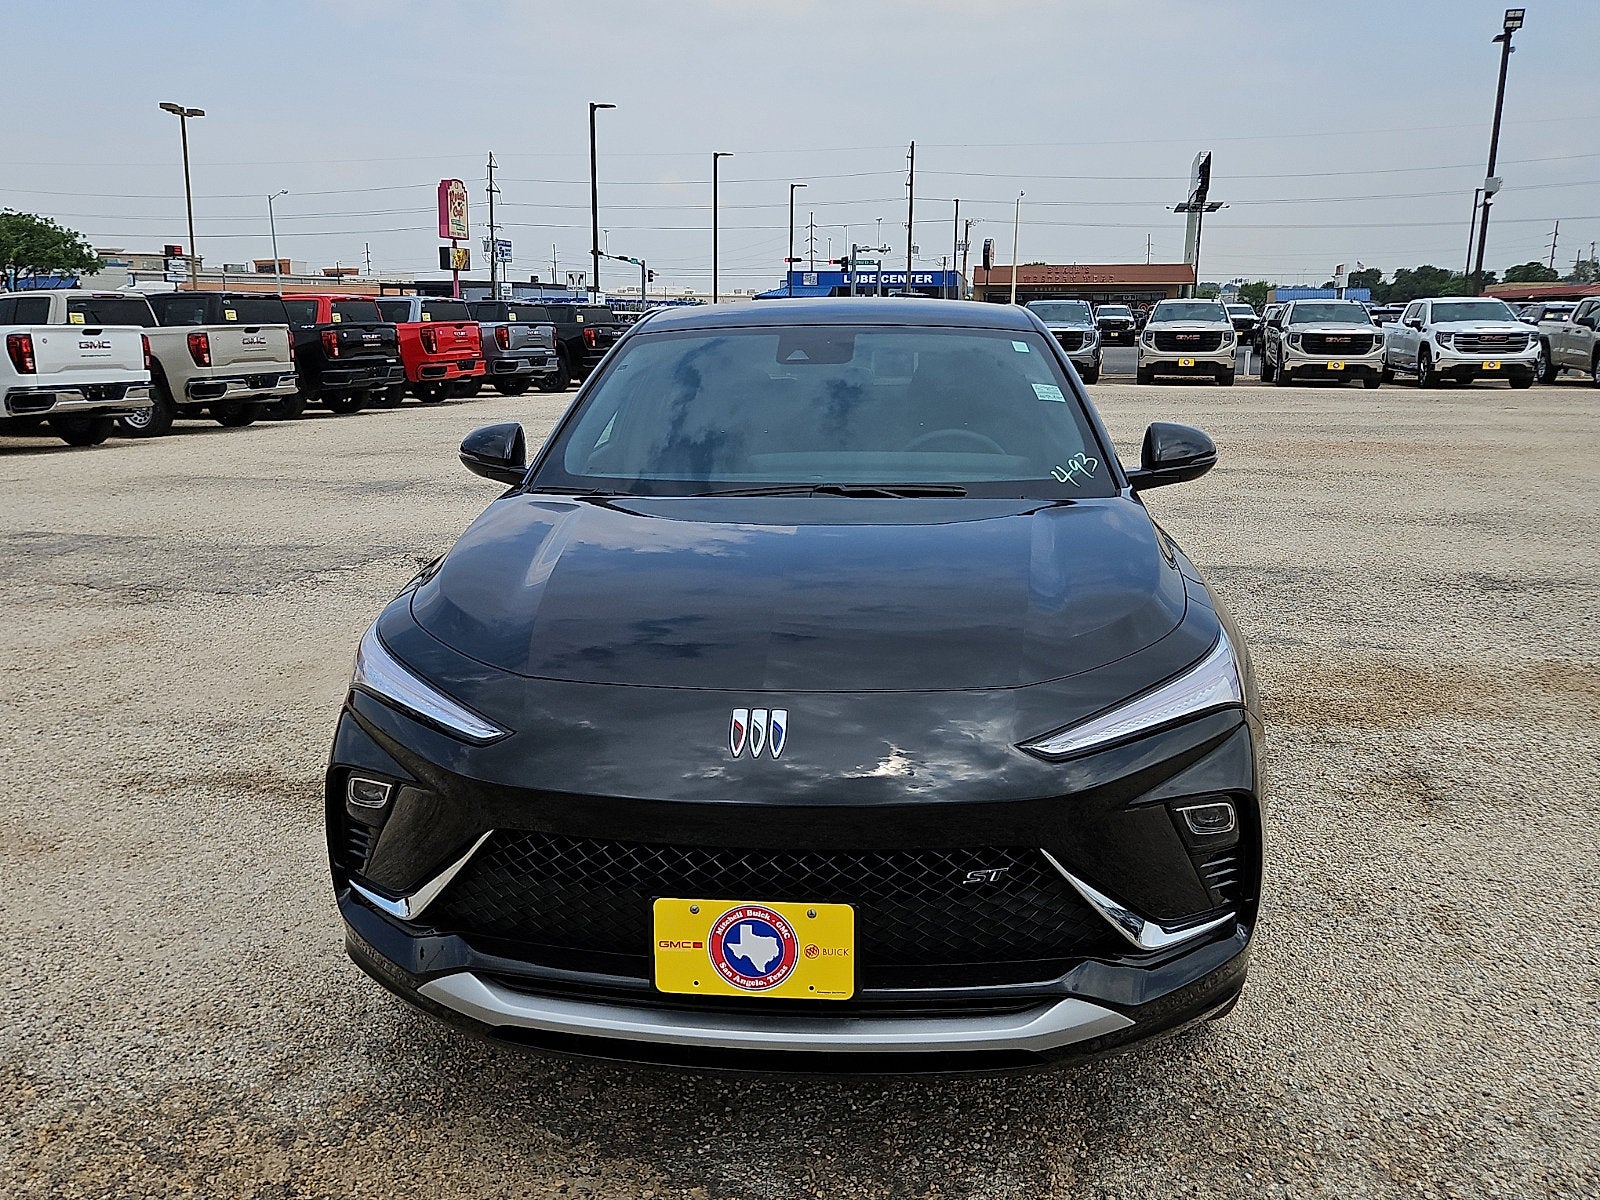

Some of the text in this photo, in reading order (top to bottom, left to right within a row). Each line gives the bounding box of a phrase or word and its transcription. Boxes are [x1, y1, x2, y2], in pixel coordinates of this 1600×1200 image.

[843, 274, 933, 284] LUBE CENTER
[1023, 274, 1077, 283] WESTERN
[78, 341, 111, 349] GMC
[242, 336, 267, 345] GMC
[1050, 452, 1099, 488] 493
[962, 867, 1010, 885] ST
[715, 911, 744, 936] Mitchell
[746, 909, 771, 921] Buick
[776, 921, 791, 940] GMC
[658, 940, 692, 949] GMC
[822, 948, 849, 956] BUICK
[719, 962, 789, 987] San Angelo, Texas
